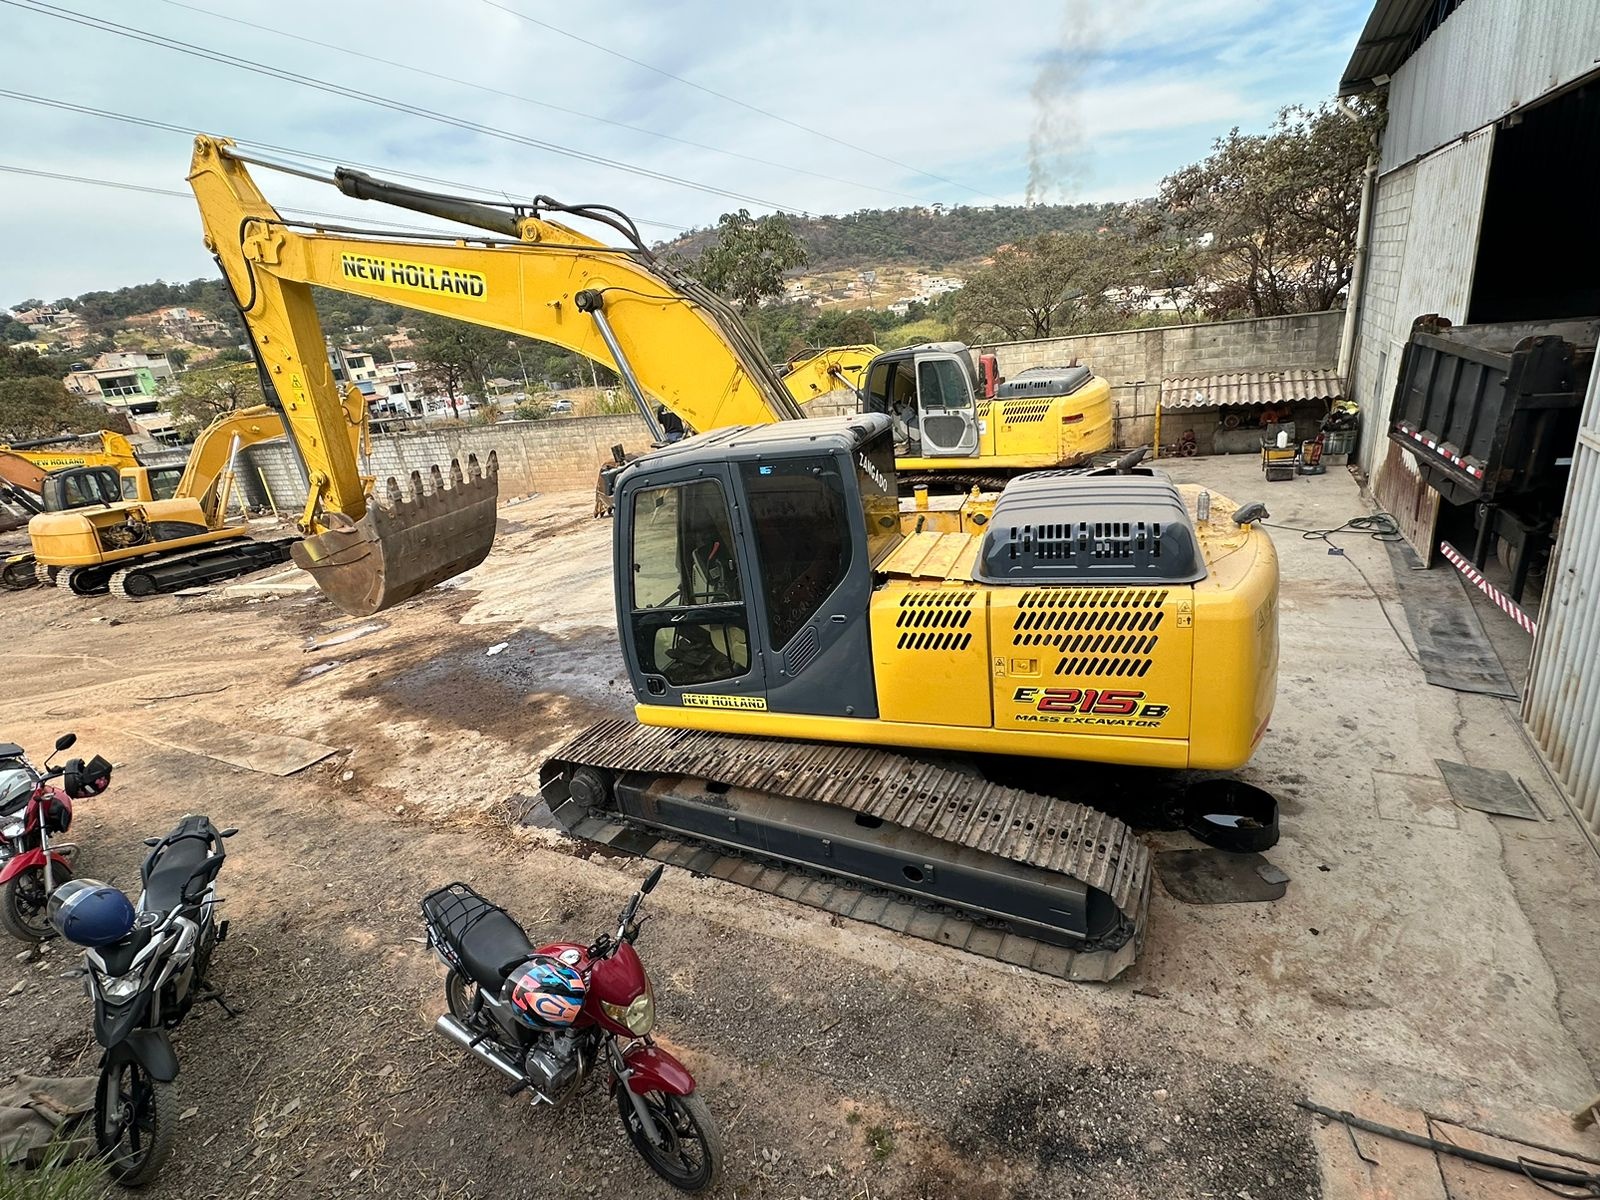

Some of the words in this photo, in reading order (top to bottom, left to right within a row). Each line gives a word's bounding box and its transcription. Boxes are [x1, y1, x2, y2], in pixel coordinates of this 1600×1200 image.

[342, 255, 385, 282] NEW
[391, 262, 484, 297] HOLLAND
[51, 458, 85, 466] HOLLAND
[859, 452, 888, 492] ZANGADO
[683, 694, 709, 706] NEW
[712, 696, 765, 709] HOLLAND
[1015, 714, 1060, 723] MASS
[1063, 717, 1162, 728] EXCAVATOR
